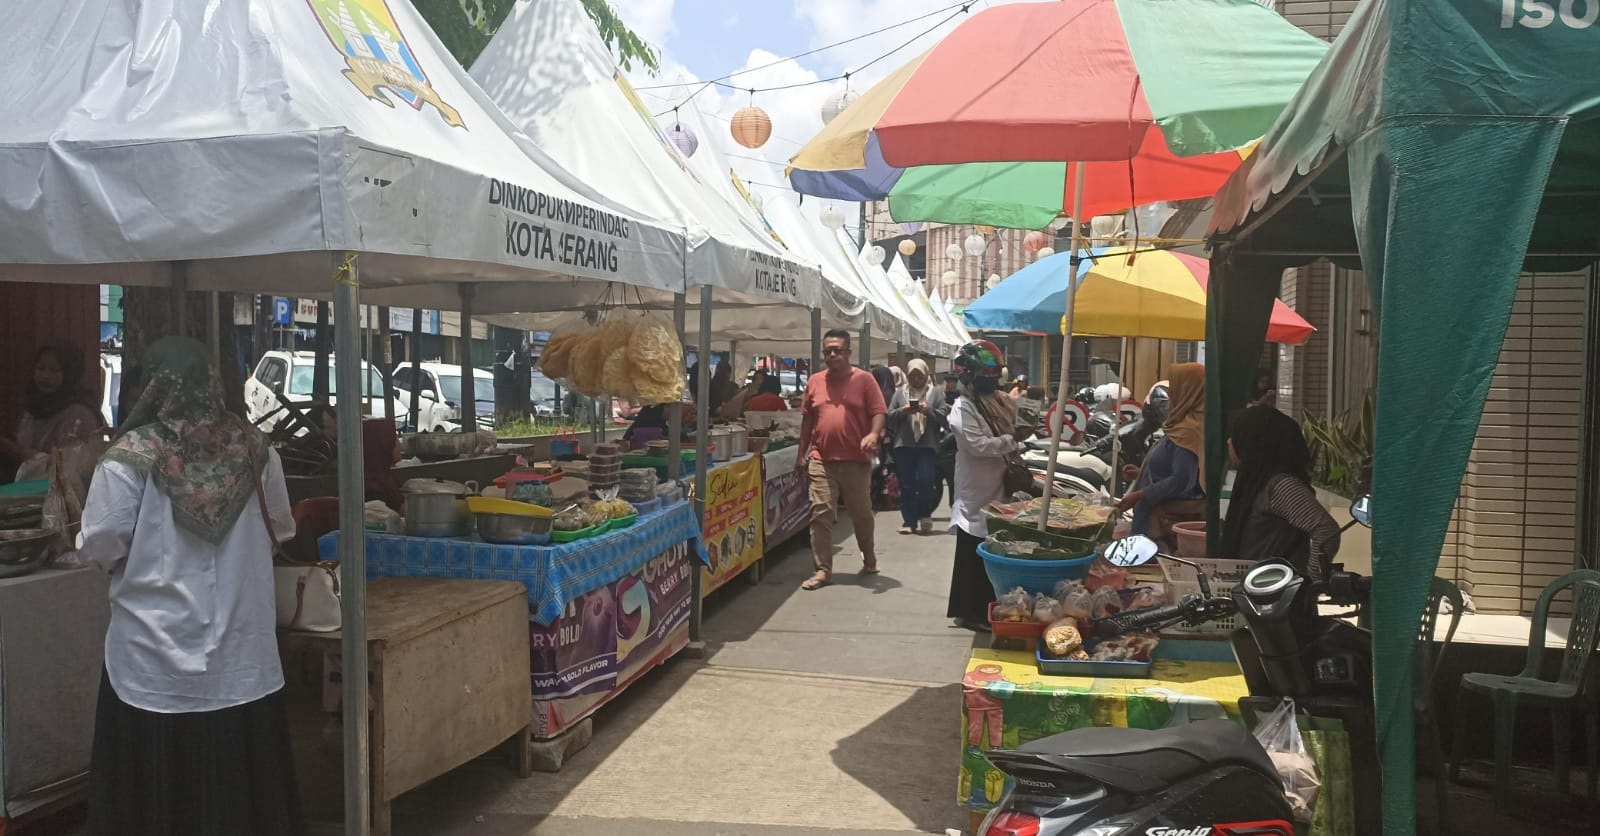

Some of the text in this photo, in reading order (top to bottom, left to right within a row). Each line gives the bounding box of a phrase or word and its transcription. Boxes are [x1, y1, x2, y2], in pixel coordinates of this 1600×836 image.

[506, 217, 555, 261] KOTA
[277, 301, 288, 321] P
[560, 624, 580, 646] BOLD
[582, 659, 609, 674] FLAVOR
